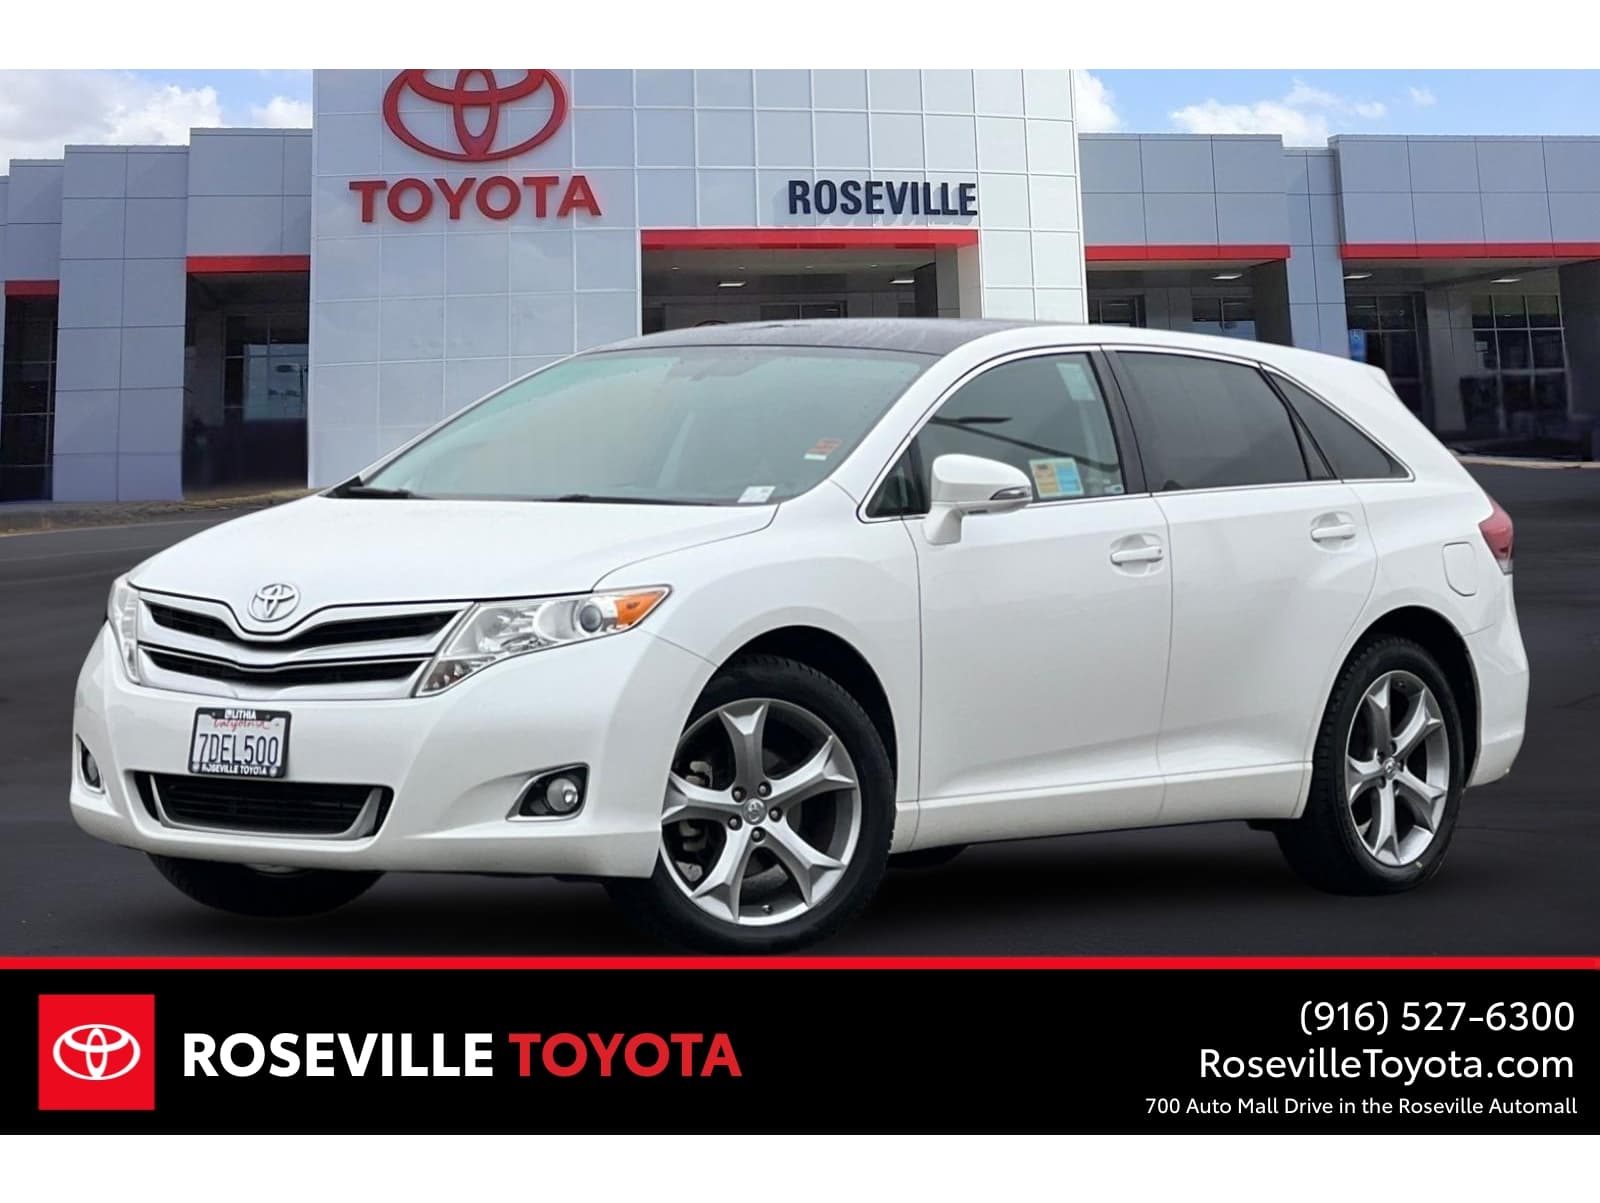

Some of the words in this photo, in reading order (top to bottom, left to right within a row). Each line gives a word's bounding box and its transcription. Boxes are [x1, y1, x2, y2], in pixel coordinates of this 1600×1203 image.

[349, 175, 602, 223] TOYOTA
[788, 179, 978, 216] ROSEVILLE
[232, 709, 257, 719] LITHIA
[199, 733, 279, 765] 7DEL500
[240, 765, 267, 775] TOYOTA
